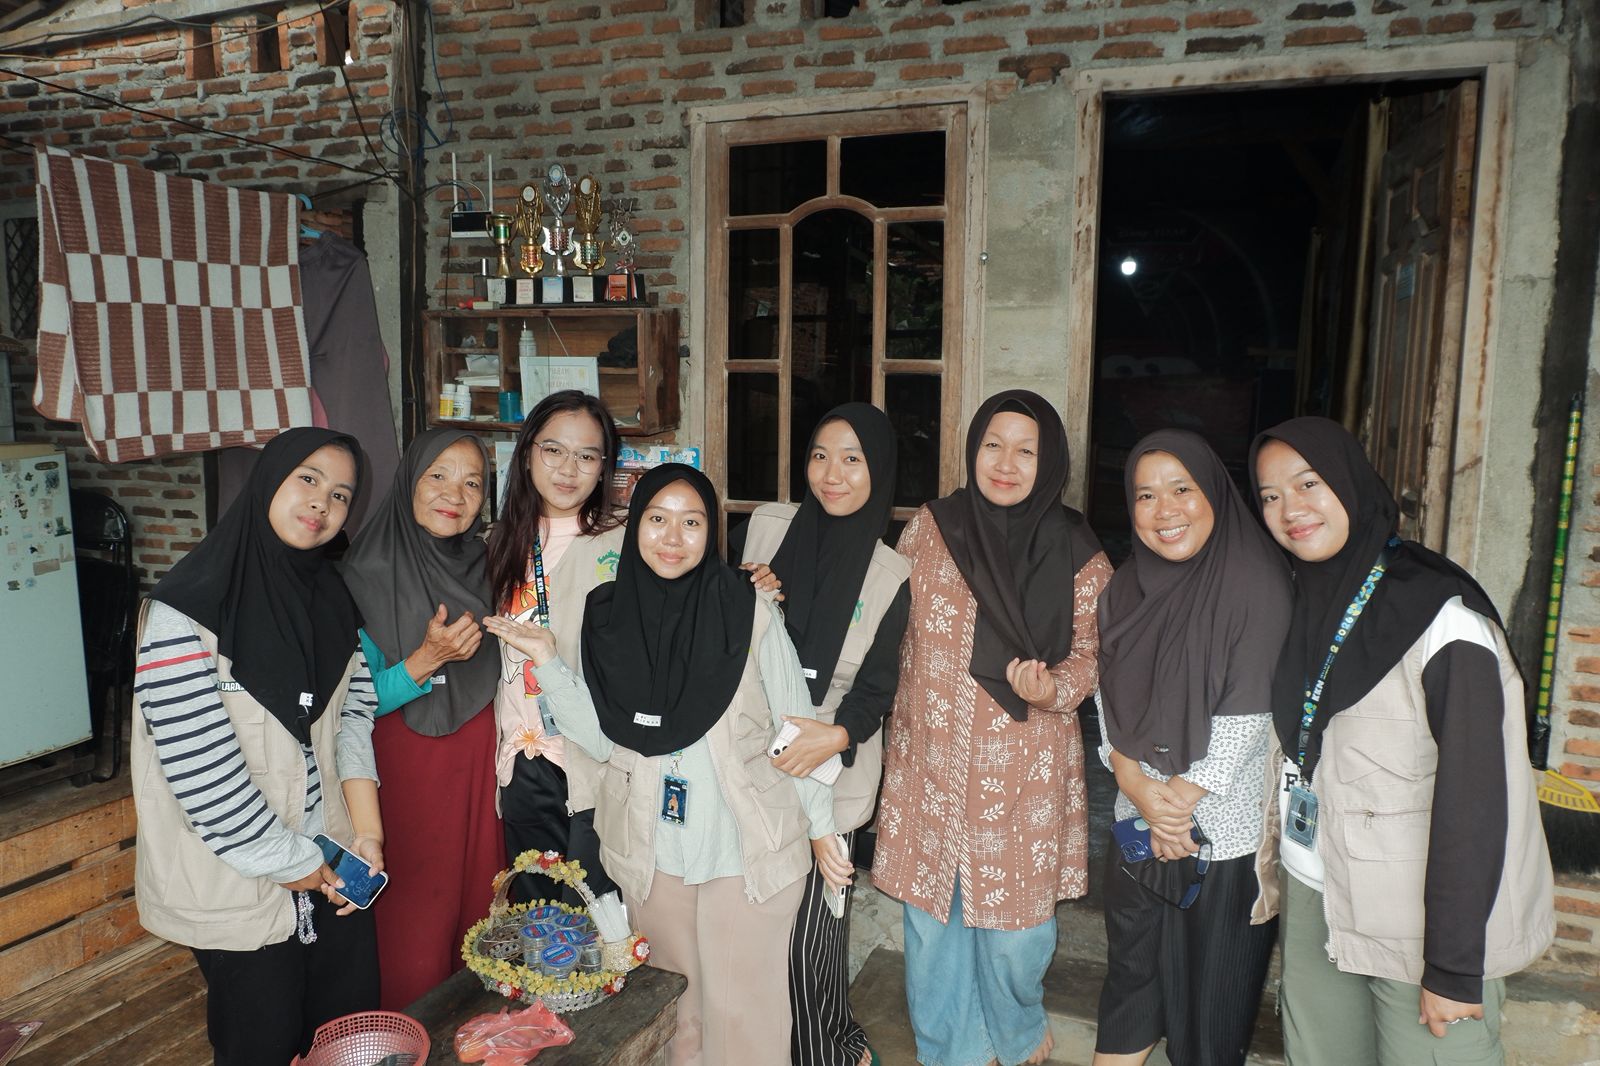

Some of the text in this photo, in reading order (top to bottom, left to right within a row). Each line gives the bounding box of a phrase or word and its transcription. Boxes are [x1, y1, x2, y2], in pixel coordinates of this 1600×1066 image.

[535, 556, 543, 576] 2026
[536, 577, 544, 593] KKN
[1311, 679, 1325, 702] KKN
[1334, 616, 1354, 642] 2026
